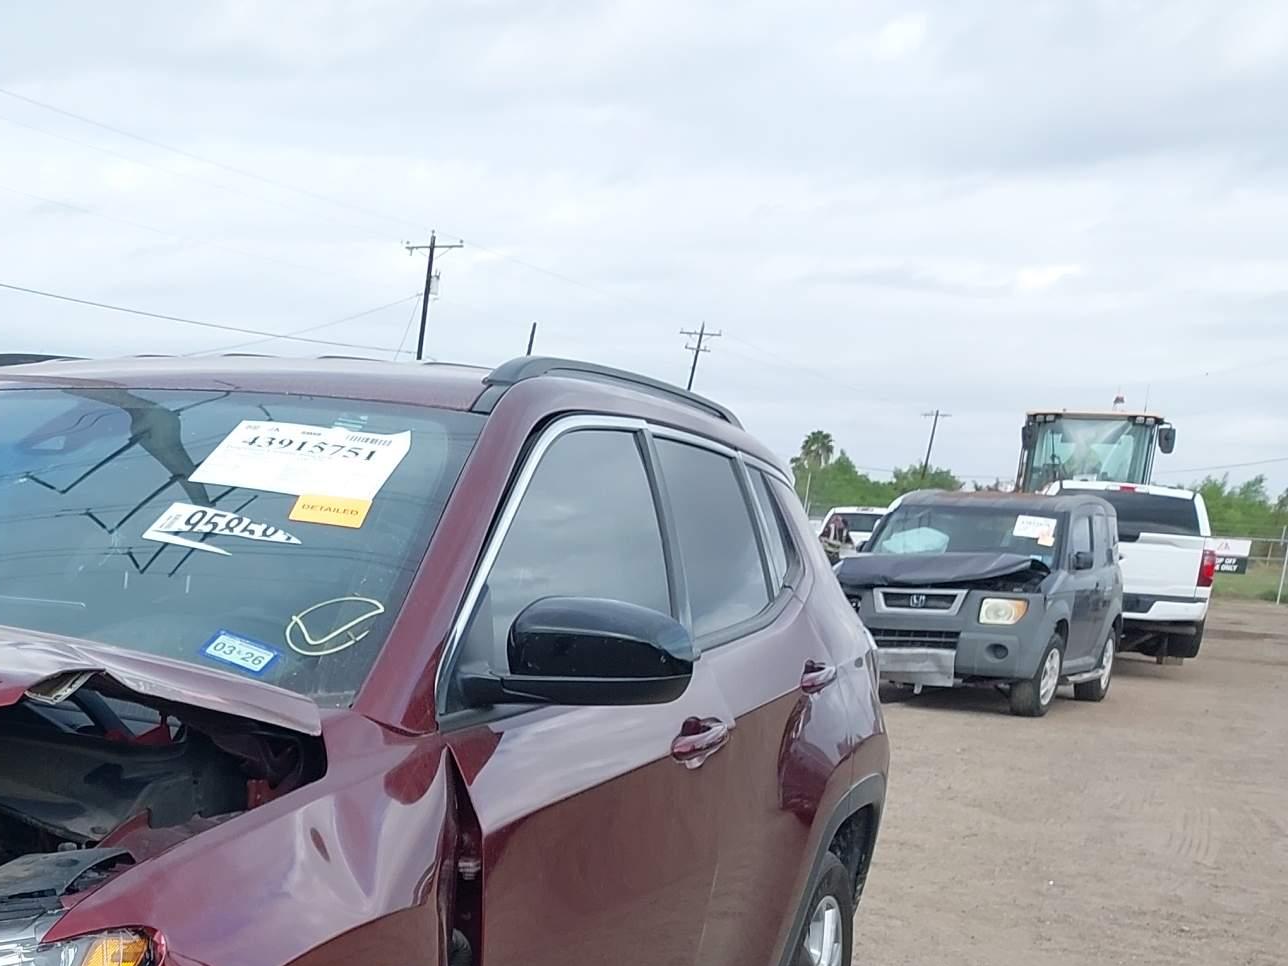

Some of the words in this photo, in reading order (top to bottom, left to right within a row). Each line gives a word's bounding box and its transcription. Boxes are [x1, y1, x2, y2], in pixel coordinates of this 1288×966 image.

[242, 435, 377, 461] 43915751
[301, 503, 360, 516] DETAILED
[213, 641, 236, 655] 03
[241, 651, 265, 665] 26
